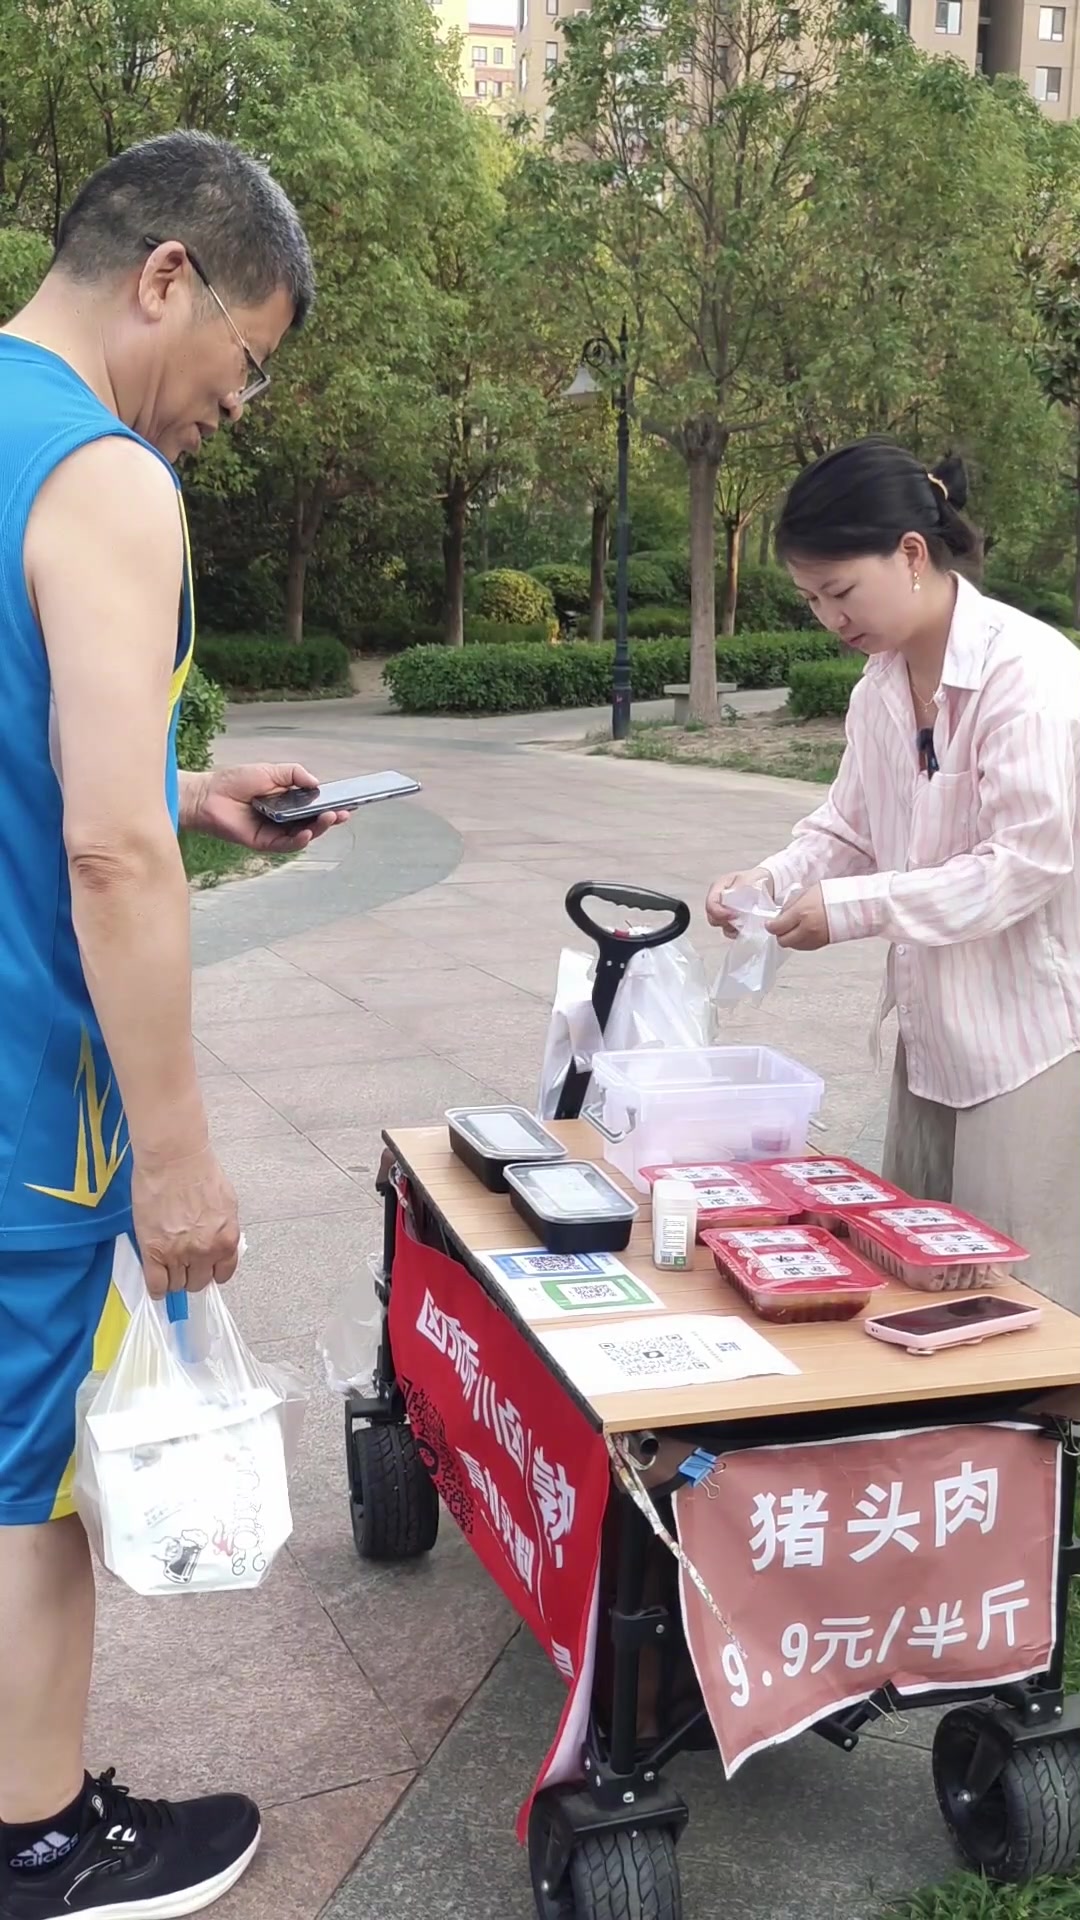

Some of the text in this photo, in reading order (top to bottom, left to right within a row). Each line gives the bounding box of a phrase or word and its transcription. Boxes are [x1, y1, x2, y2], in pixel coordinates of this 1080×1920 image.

[748, 1461, 999, 1571] 猪头肉
[721, 1579, 1030, 1707] 9.9元/半斤
[9, 1833, 79, 1868] adidas
